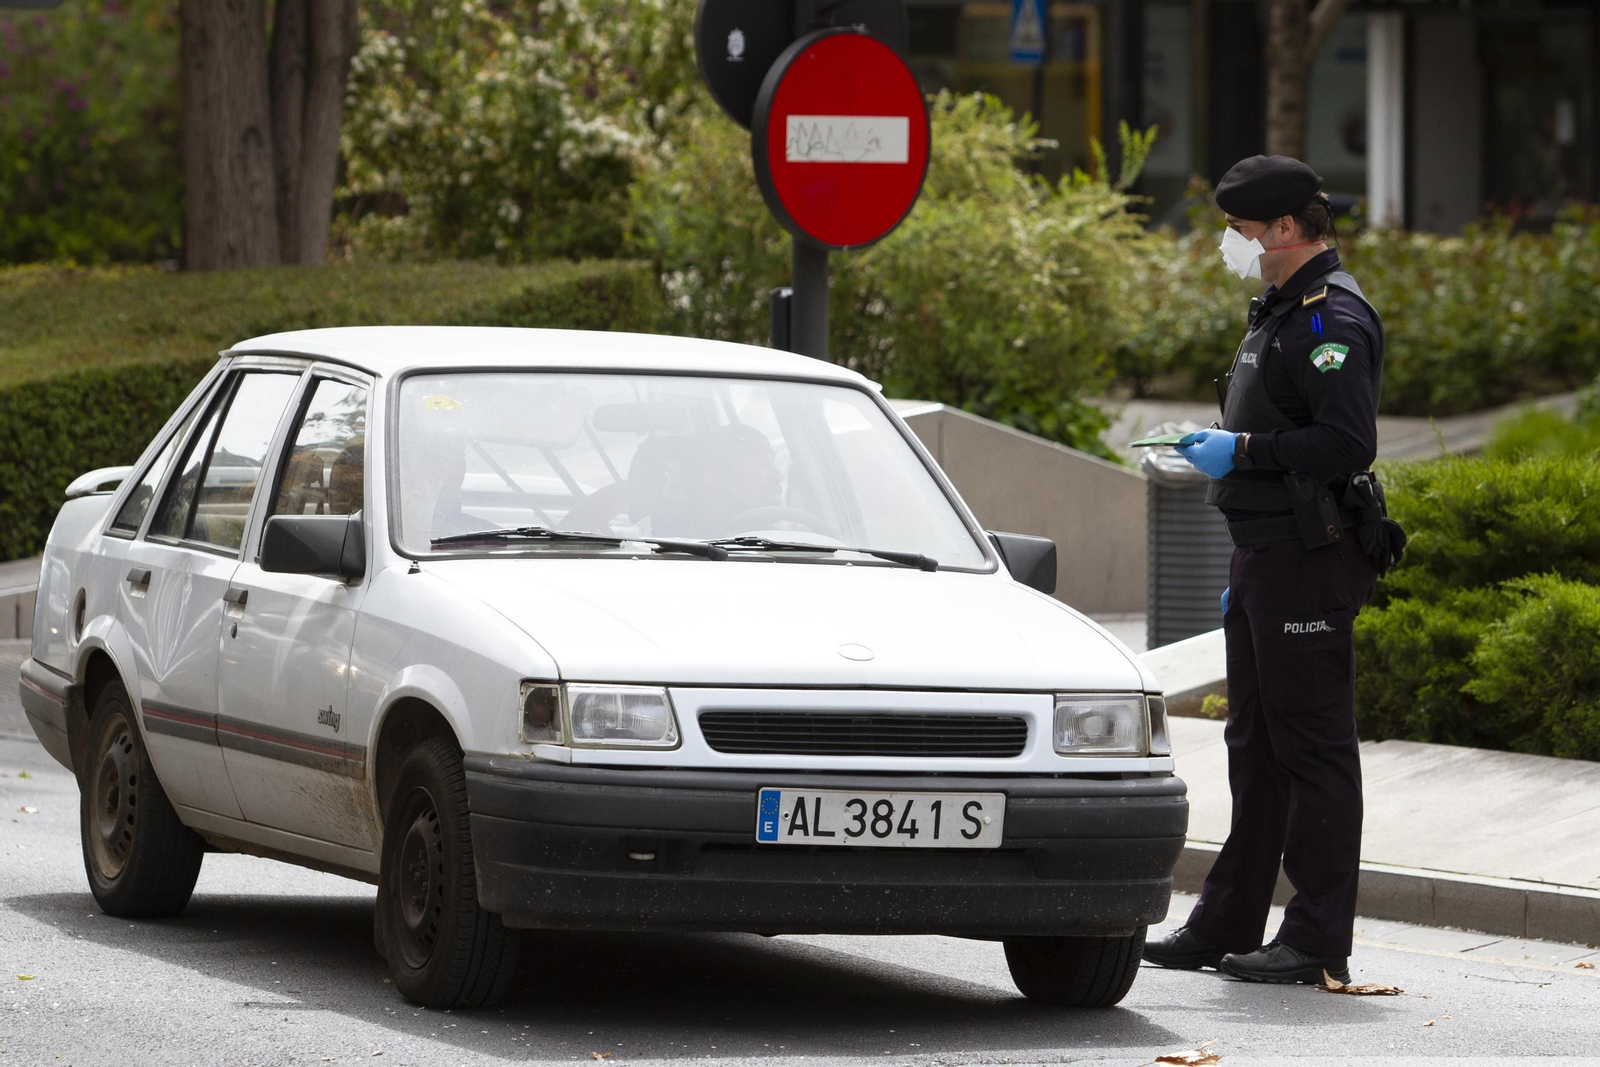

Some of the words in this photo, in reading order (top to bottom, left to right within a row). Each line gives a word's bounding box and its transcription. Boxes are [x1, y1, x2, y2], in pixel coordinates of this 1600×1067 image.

[1284, 620, 1327, 634] POLICIA
[787, 796, 836, 837] AL
[843, 797, 942, 840] 3841
[960, 800, 983, 840] S
[764, 821, 774, 833] E
